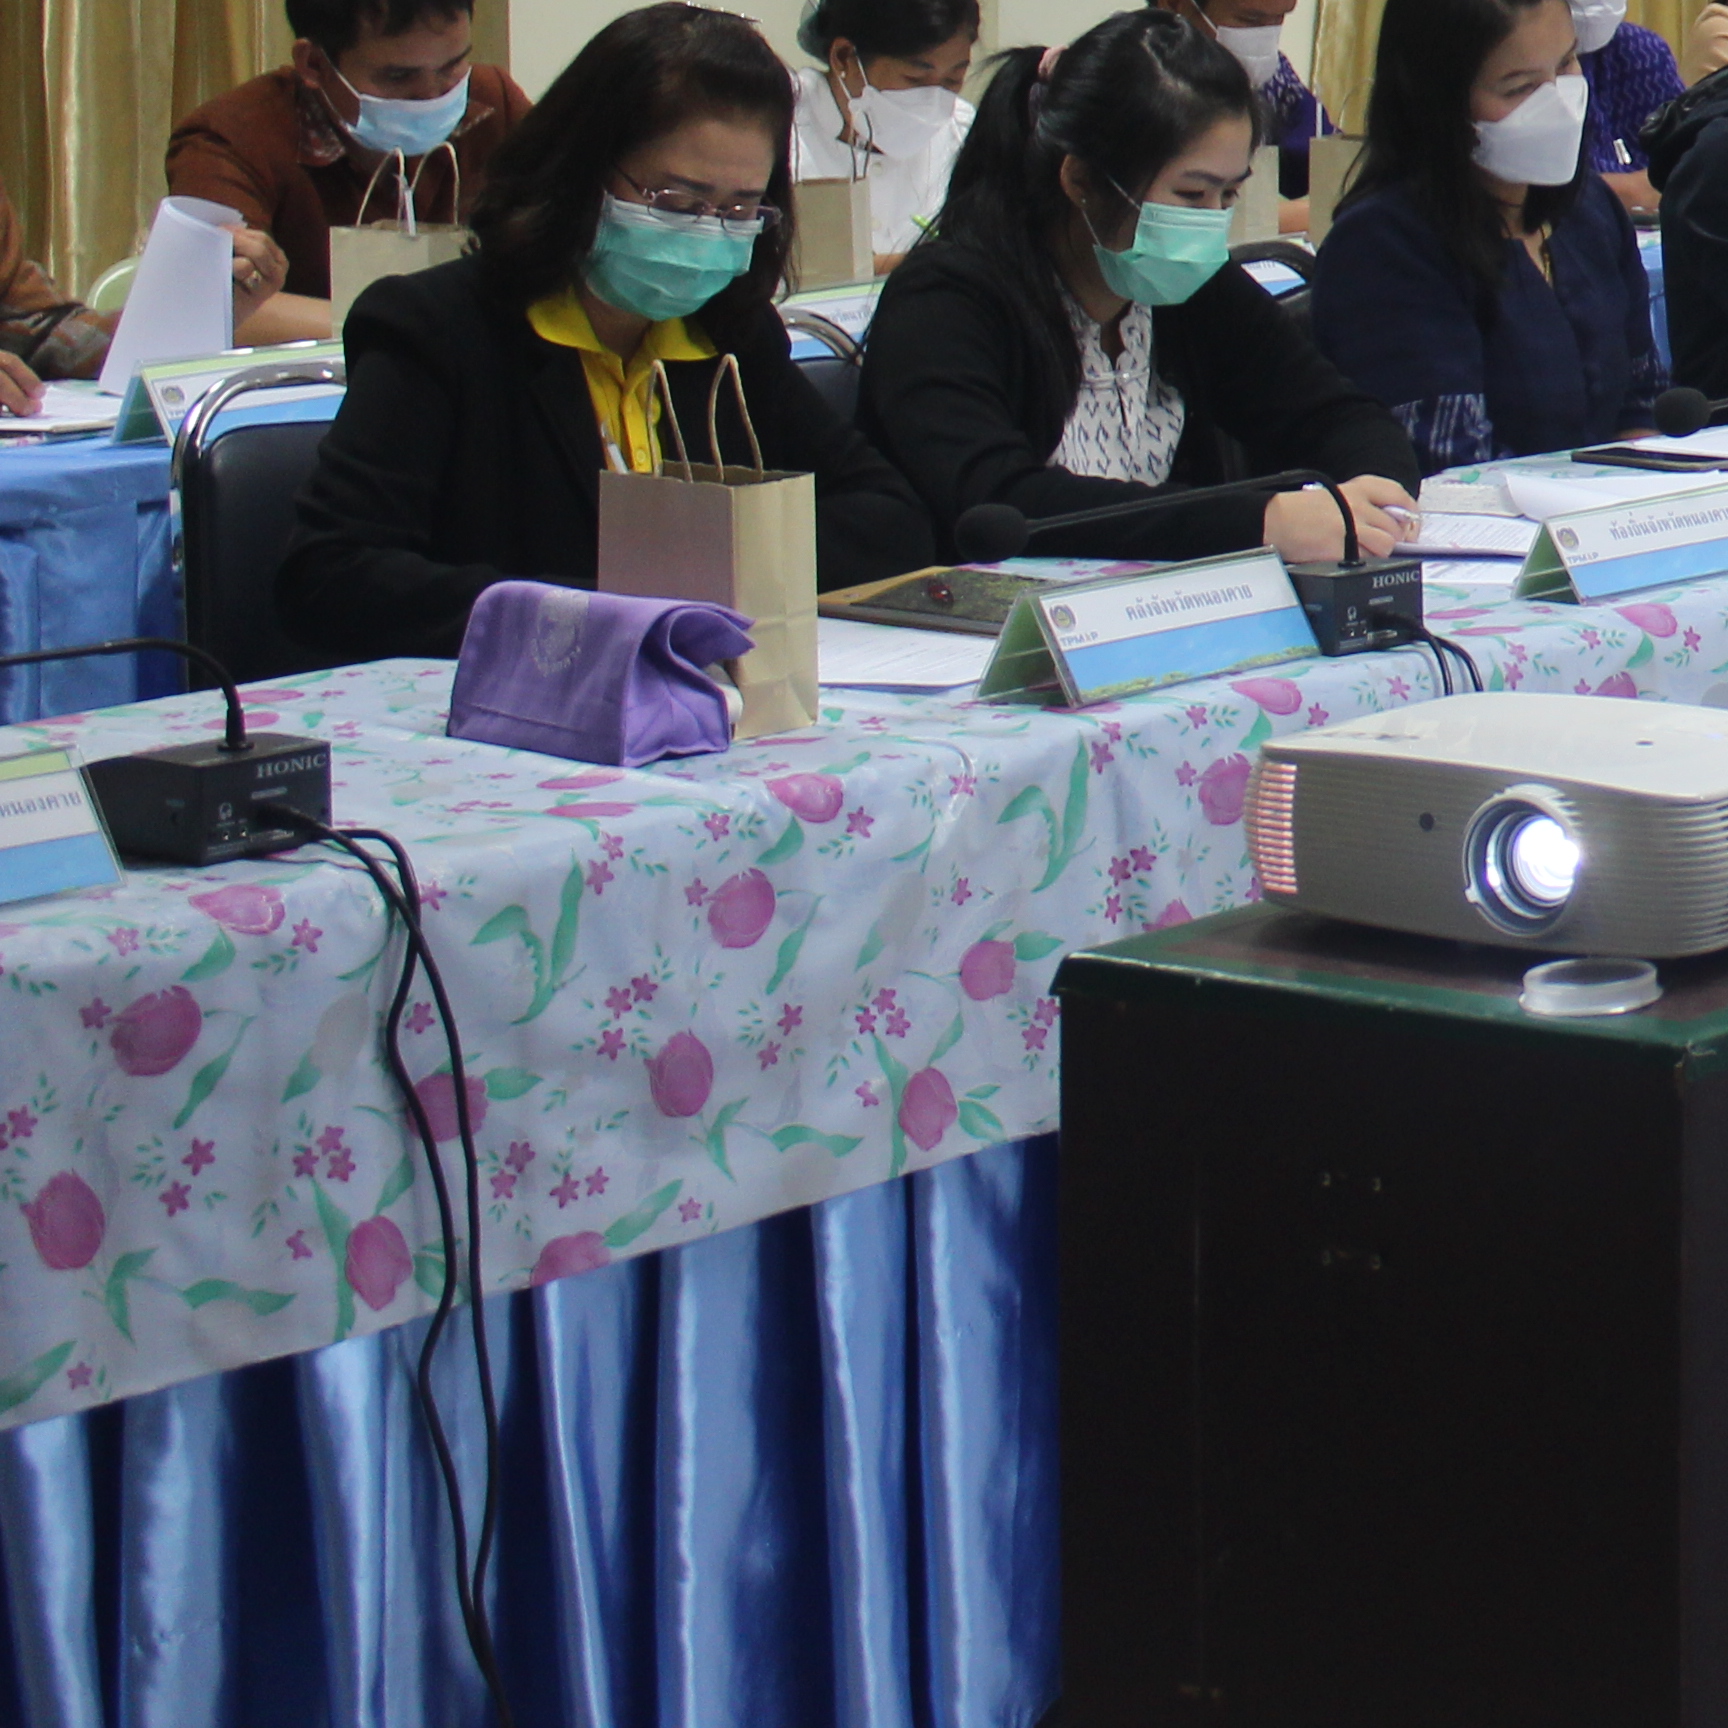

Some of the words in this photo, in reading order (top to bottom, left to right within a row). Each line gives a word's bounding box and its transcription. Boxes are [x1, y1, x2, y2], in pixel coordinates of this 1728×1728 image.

[1371, 570, 1420, 589] HONIC
[1125, 582, 1254, 622] คลังจังหวัดหนองคาย
[256, 751, 327, 780] HONIC
